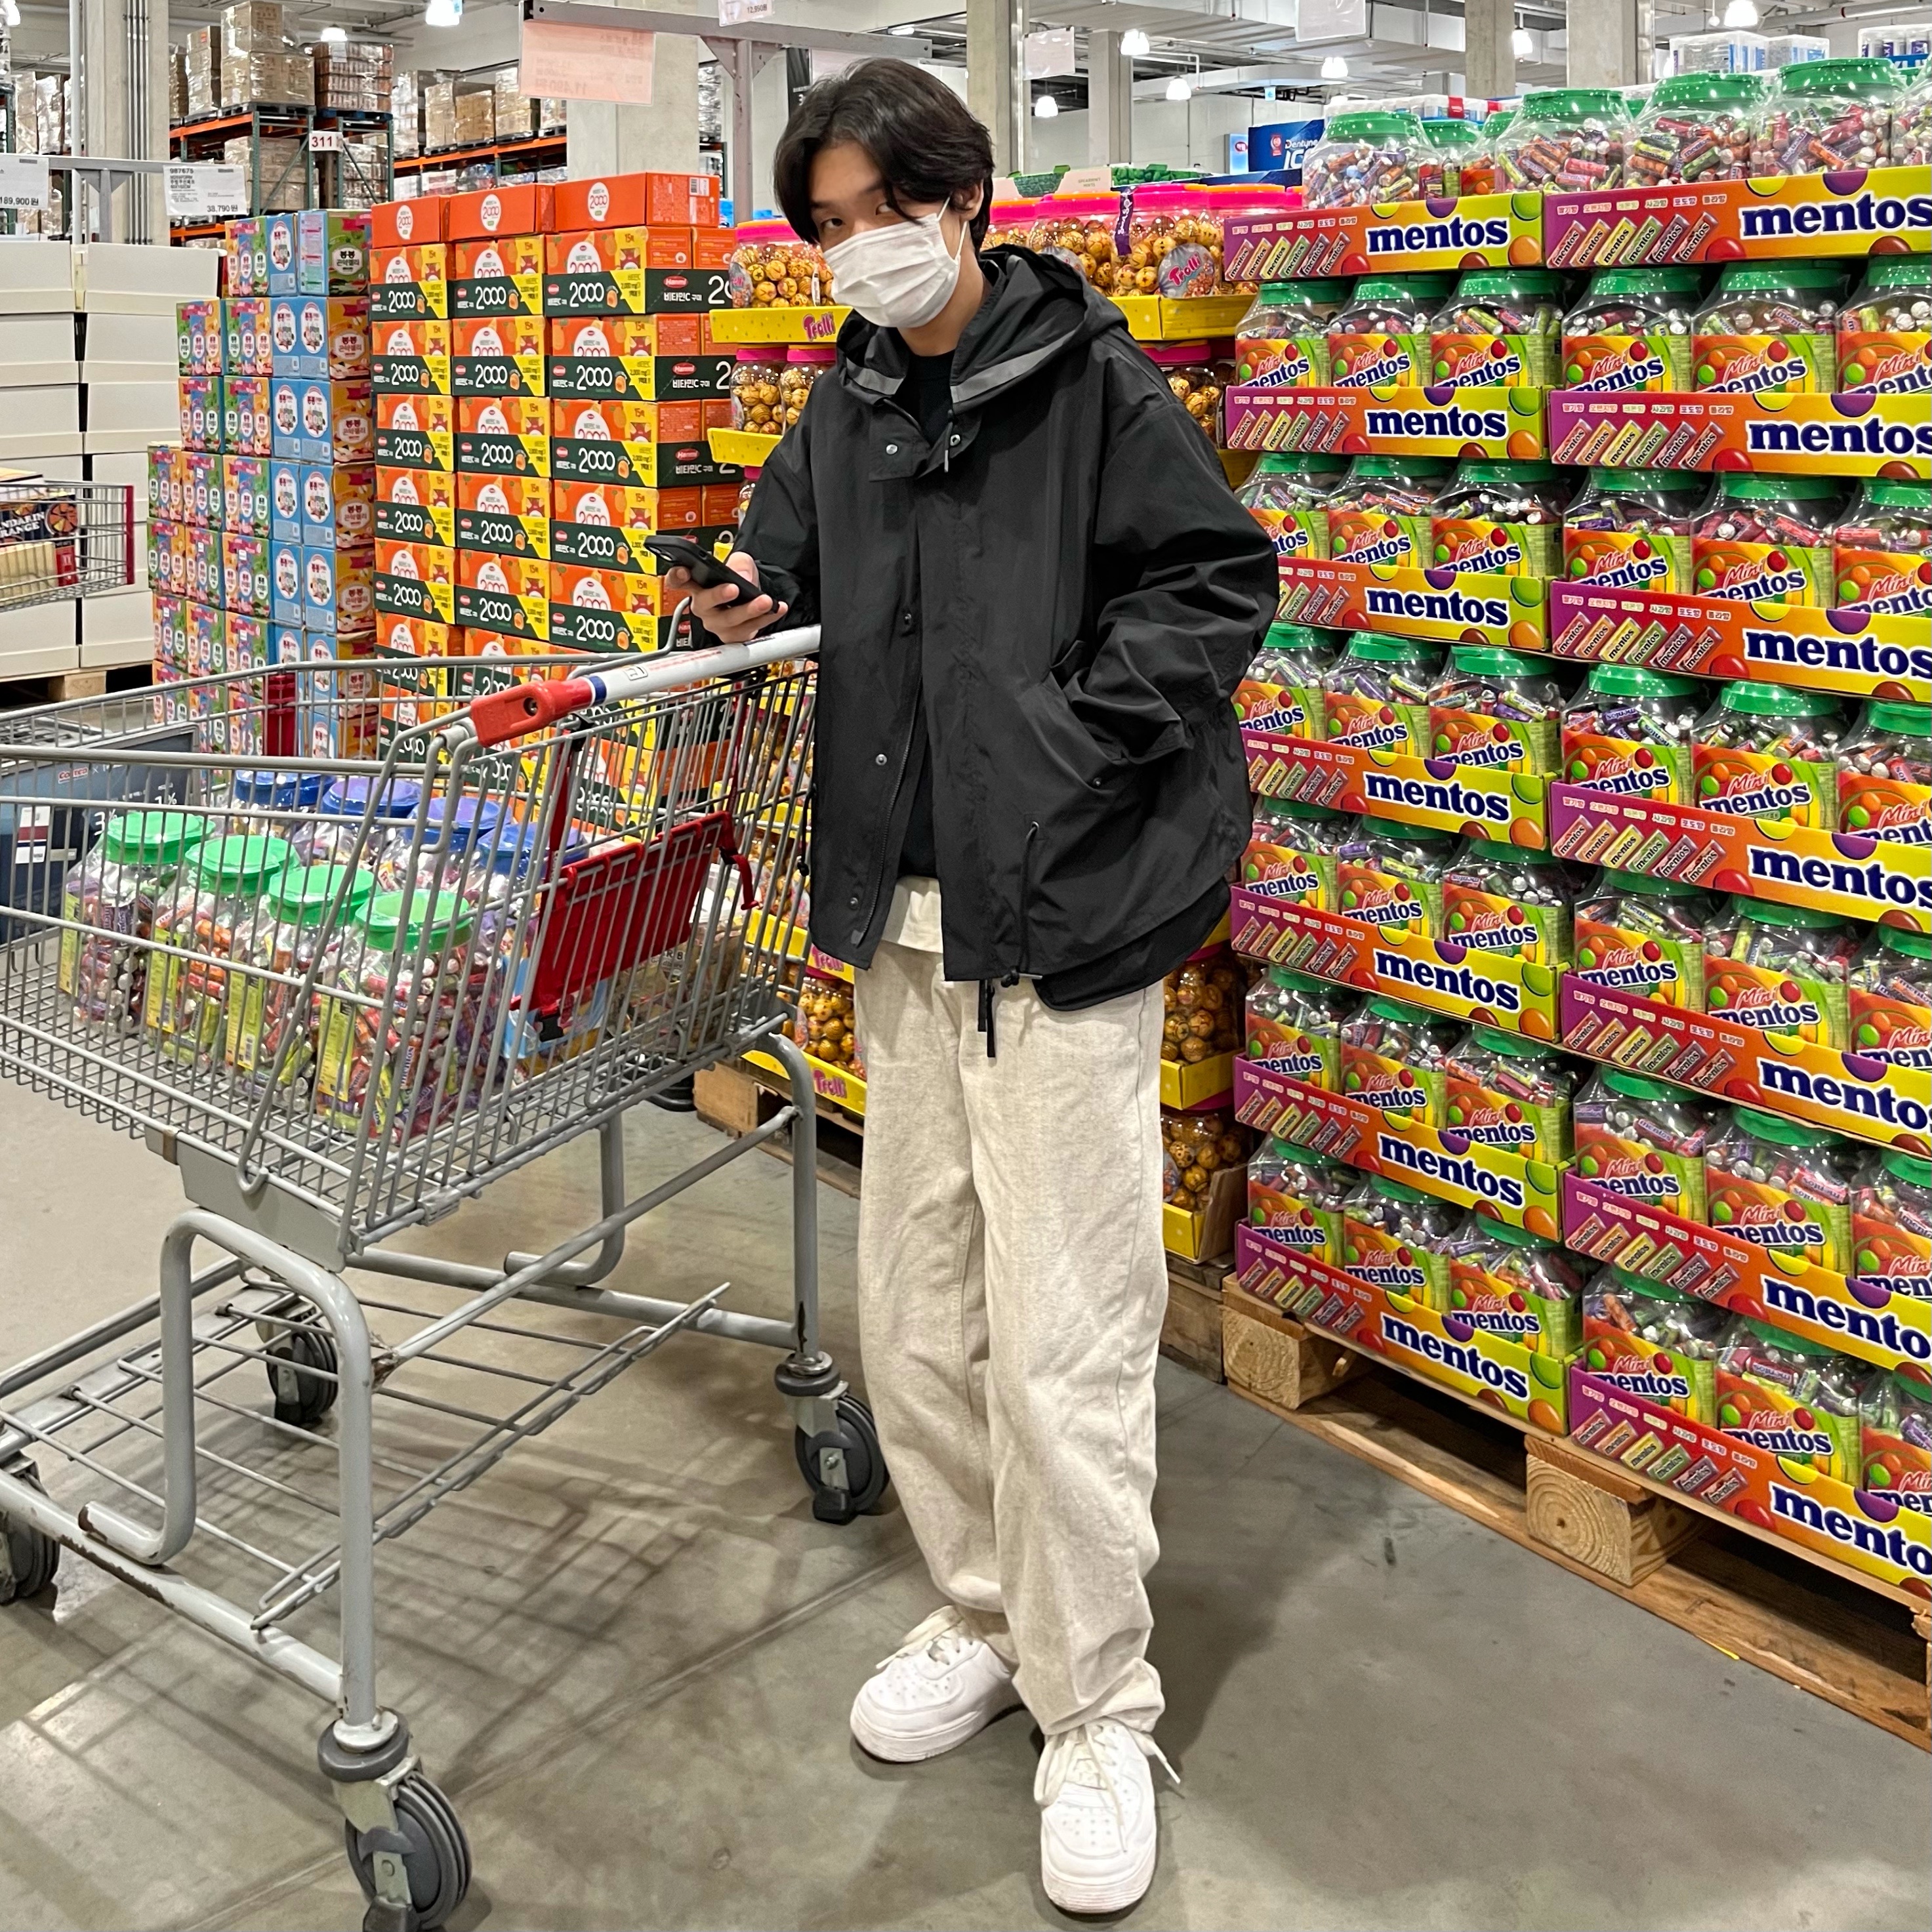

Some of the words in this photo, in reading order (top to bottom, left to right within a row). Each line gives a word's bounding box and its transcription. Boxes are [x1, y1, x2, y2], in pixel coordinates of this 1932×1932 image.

[312, 136, 333, 148] 311
[1285, 139, 1319, 149] Dentyne
[1283, 149, 1305, 170] IC
[483, 205, 499, 220] 2000
[590, 195, 607, 209] 2000
[1674, 197, 1697, 206] 포도향
[398, 215, 413, 229] 2000
[1742, 194, 1932, 236] mentos
[1368, 218, 1508, 253] mentos
[1555, 231, 1579, 265] mentos
[1579, 230, 1603, 264] mentos
[1604, 228, 1629, 263] mentos
[1629, 227, 1655, 262] mentos
[1655, 224, 1682, 262] mentos
[1682, 222, 1709, 260] mentos
[1168, 252, 1202, 287] Trolli
[388, 291, 416, 312] 2000
[475, 286, 506, 310] 2000
[569, 281, 605, 307] 2000
[664, 292, 691, 302] 비타민C
[803, 312, 836, 342] Trolli
[1334, 358, 1410, 386] mentos
[1353, 354, 1380, 377] Mini
[1458, 350, 1489, 369] Mini
[1592, 354, 1626, 379] Mini
[1726, 352, 1764, 379] Mini
[1878, 351, 1922, 382] Mini
[391, 363, 419, 385] 2000
[475, 364, 507, 388] 2000
[577, 365, 612, 390] 2000
[672, 379, 699, 388] 비타민C
[1576, 358, 1665, 392] mentos
[1367, 407, 1507, 438] mentos
[395, 437, 422, 459] 2000
[1560, 430, 1585, 462] mentos
[1585, 430, 1609, 462] mentos
[1610, 432, 1635, 464] mentos
[1635, 432, 1662, 466] mentos
[1662, 432, 1689, 467] mentos
[1748, 418, 1932, 455] mentos
[482, 443, 514, 466] 2000
[578, 447, 615, 473] 2000
[1689, 434, 1716, 468] mentos
[676, 464, 703, 474] 비타민C
[395, 510, 423, 533] 2000
[481, 520, 514, 544] 2000
[578, 532, 615, 558] 2000
[1272, 531, 1308, 554] ntos
[394, 583, 422, 607] 2000
[1872, 574, 1914, 602] Mini
[480, 597, 512, 623] 2000
[1367, 590, 1509, 627] mentos
[1678, 608, 1701, 617] 포도향
[576, 615, 615, 642] 2000
[1559, 623, 1584, 653] mentos
[1584, 625, 1609, 655] mentos
[1609, 628, 1634, 659] mentos
[1634, 632, 1660, 663] mentos
[1660, 634, 1687, 666] mentos
[1687, 638, 1714, 670] mentos
[1746, 631, 1932, 680] mentos
[1458, 730, 1491, 752] Mini
[58, 768, 89, 781] COTCO
[1594, 758, 1628, 784] Mini
[1366, 773, 1510, 821] mentos
[1731, 772, 1769, 798] Mini
[1702, 786, 1811, 813] mentos
[1882, 803, 1926, 832] Mini
[1248, 873, 1318, 897] mentos
[1344, 901, 1422, 922] mentos
[1363, 888, 1392, 909] Mini
[1474, 913, 1504, 932] Mini
[1451, 926, 1538, 949] mentos
[1603, 948, 1638, 971] Mini
[1376, 951, 1520, 1011] mentos
[1580, 962, 1677, 988] mentos
[1738, 987, 1777, 1011] Mini
[1710, 1003, 1819, 1027] mentos
[813, 1068, 848, 1100] Trolli
[1761, 1061, 1932, 1130] mento
[1471, 1108, 1504, 1126] Mini
[1380, 1136, 1523, 1207] mentos
[1741, 1203, 1780, 1225] Mini
[1472, 1292, 1507, 1311] Mini
[1765, 1279, 1931, 1359] mento
[1383, 1315, 1528, 1399] mentos
[1750, 1406, 1792, 1429] Mini
[1773, 1486, 1932, 1576] mento
